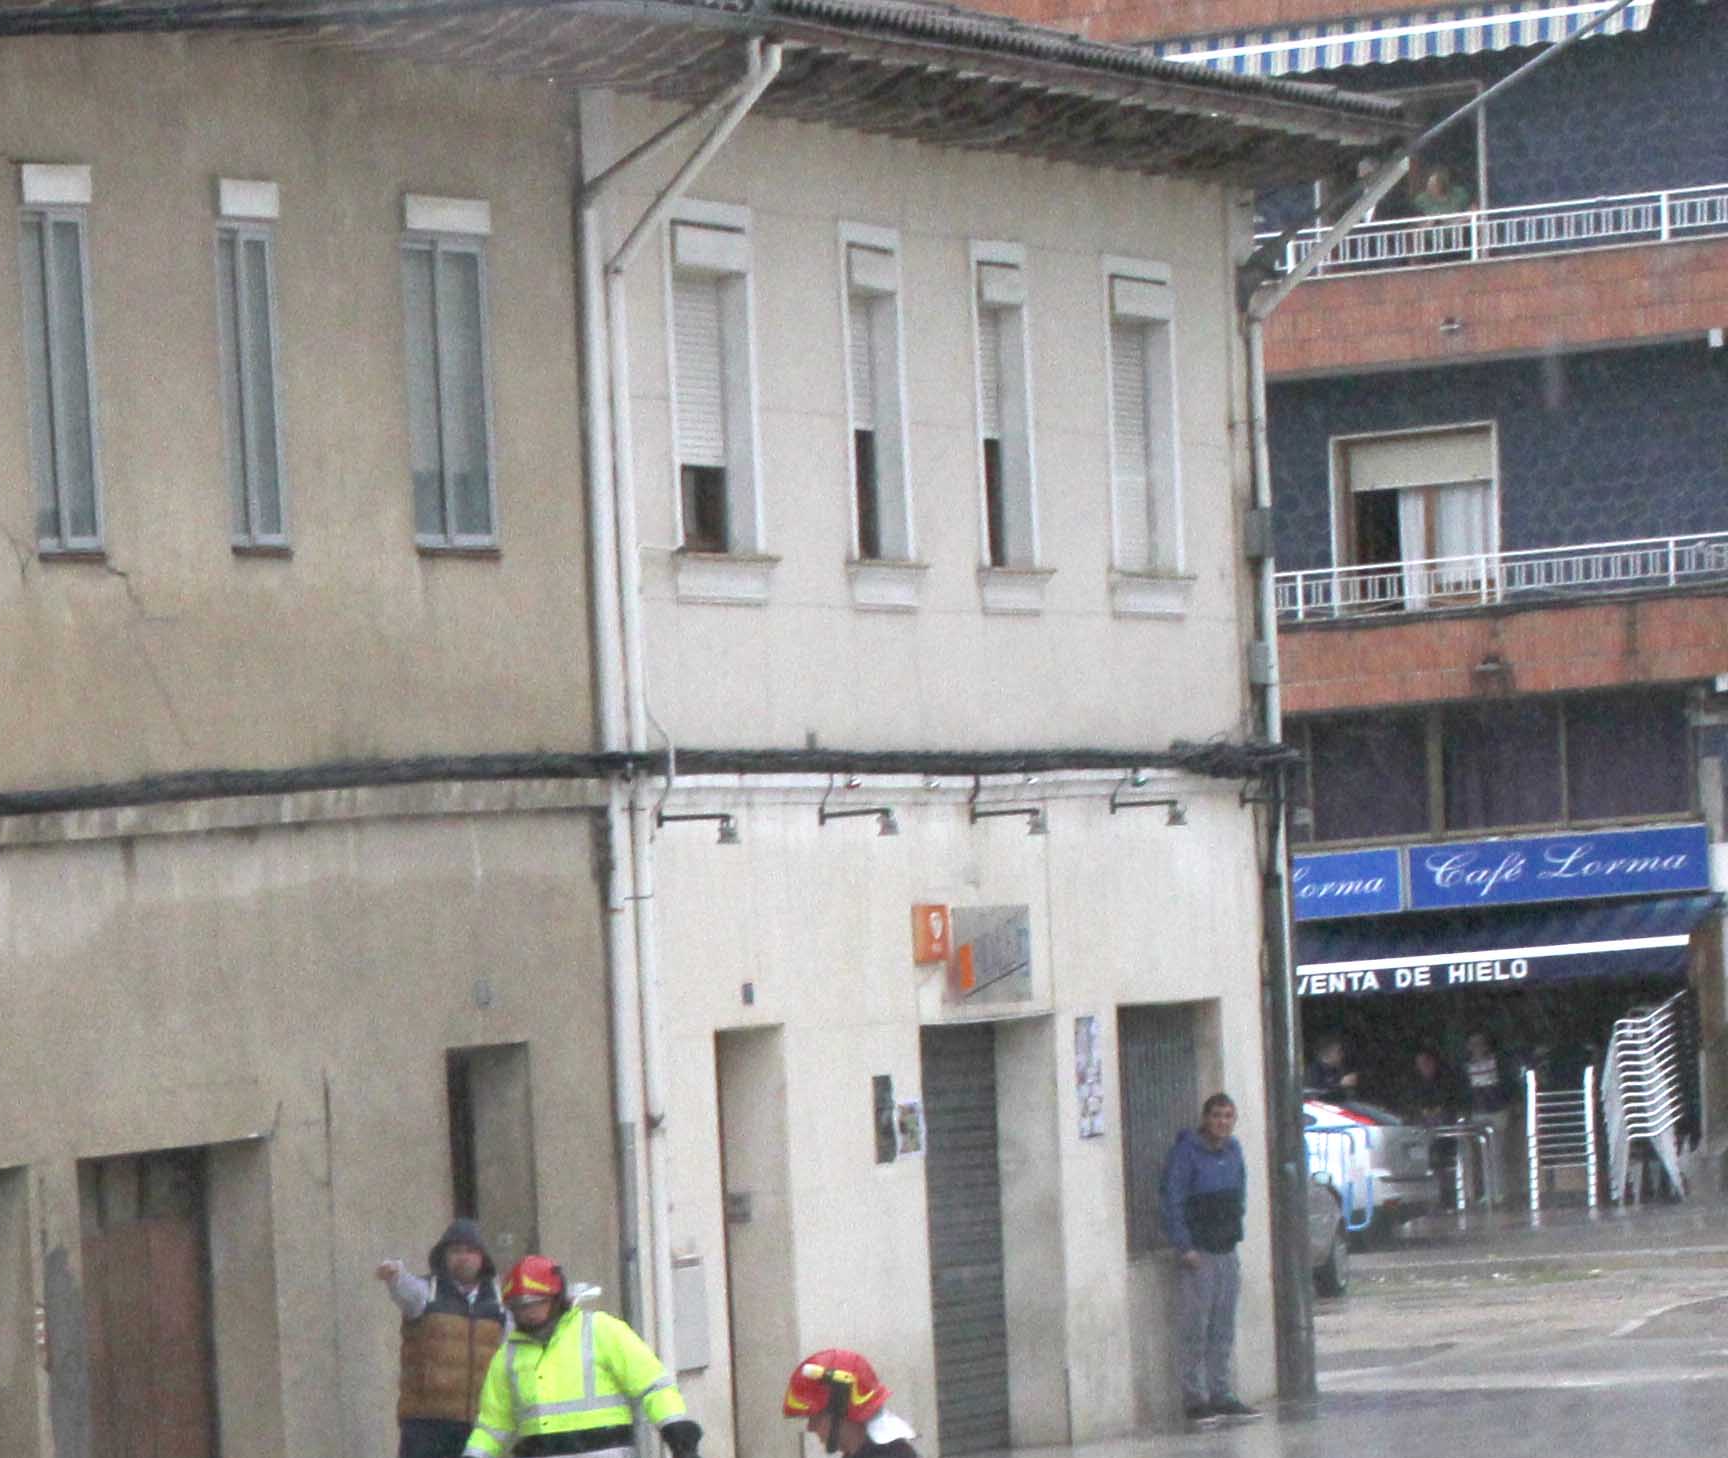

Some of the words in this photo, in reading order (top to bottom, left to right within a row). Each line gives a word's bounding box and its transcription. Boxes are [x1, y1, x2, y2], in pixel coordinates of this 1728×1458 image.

[1425, 851, 1526, 897] Café
[1536, 843, 1689, 879] Lorma
[1395, 966, 1431, 988] DE
[1448, 959, 1529, 985] HIELO
